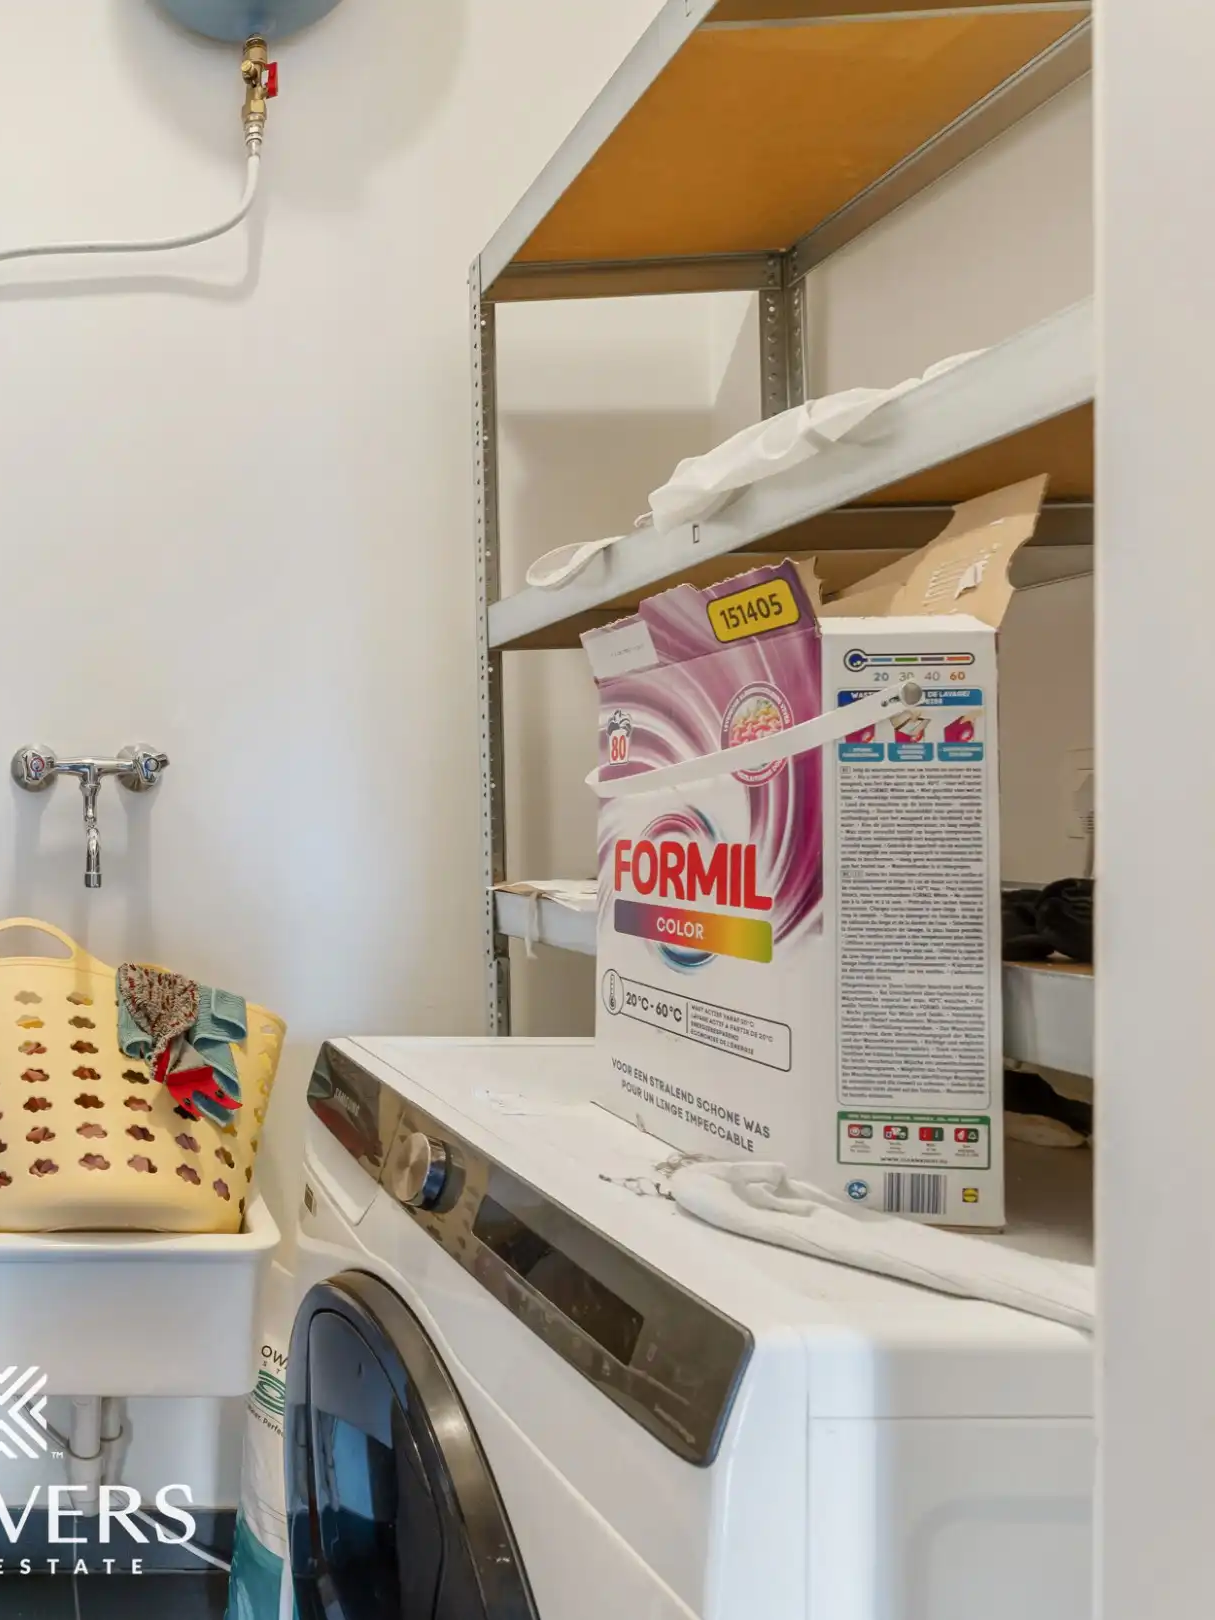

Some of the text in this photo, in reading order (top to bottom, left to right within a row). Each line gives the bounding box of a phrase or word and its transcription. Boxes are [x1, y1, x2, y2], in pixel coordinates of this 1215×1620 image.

[719, 593, 783, 630] 151405
[873, 672, 889, 682] 20
[924, 671, 941, 681] 40
[949, 671, 966, 681] 60
[611, 735, 626, 761] 80
[614, 839, 773, 911] FORMIL
[656, 916, 705, 940] COLOR
[626, 992, 649, 1011] 20°C
[656, 1001, 682, 1022] 60°C
[750, 1030, 758, 1038] DE
[612, 1057, 770, 1139] VOOR EEN STRALEND SCHONE WAS
[621, 1079, 755, 1152] POUR UN LINGE IMPECCABLE
